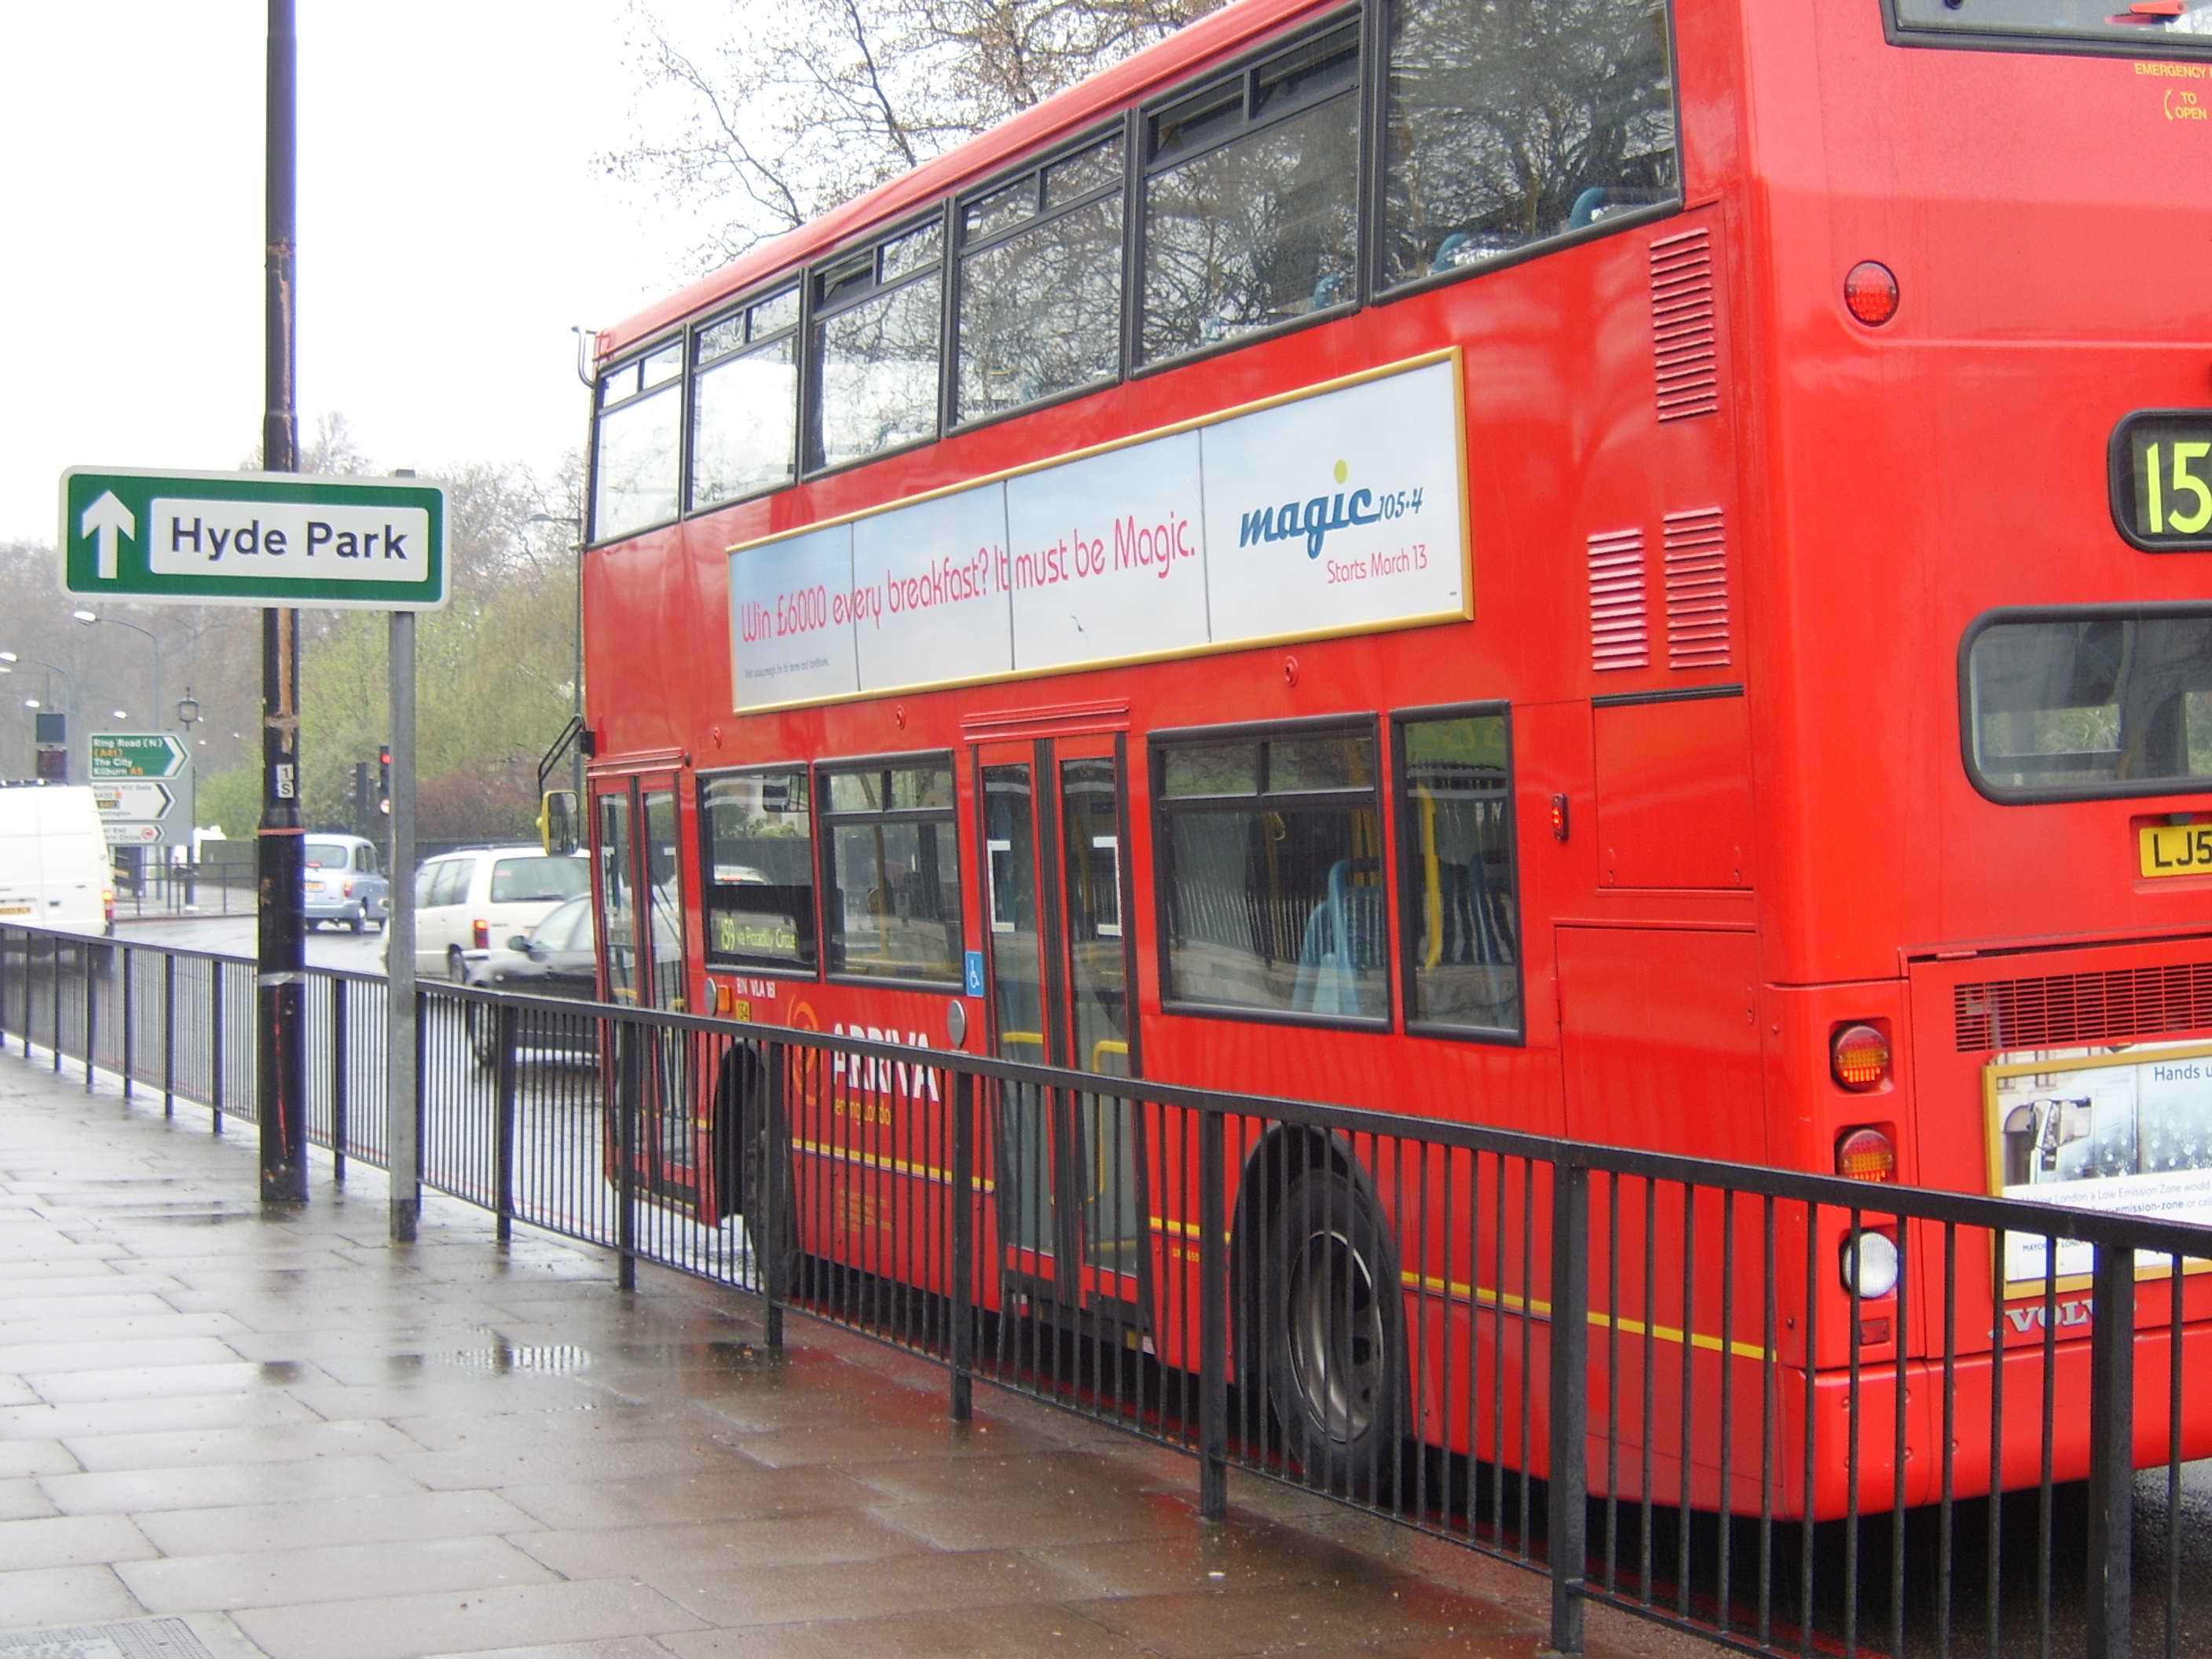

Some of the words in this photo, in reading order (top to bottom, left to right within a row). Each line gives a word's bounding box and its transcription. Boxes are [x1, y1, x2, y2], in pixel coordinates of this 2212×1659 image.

[2134, 62, 2206, 79] EMERGENCY
[2180, 91, 2198, 104] TO
[2175, 107, 2208, 120] OPEN
[1240, 471, 1379, 559] magic
[171, 516, 287, 561] Hyde
[306, 521, 408, 560] Park
[1327, 558, 1368, 584] Starts
[1371, 548, 1410, 578] March
[1412, 544, 1428, 570] 13
[741, 602, 771, 643] Win
[777, 584, 826, 637] £6000
[833, 584, 882, 630] every
[887, 547, 989, 613] breakfast?
[994, 545, 1010, 592] It
[1016, 538, 1069, 590] must
[1074, 528, 1106, 578] be
[1114, 511, 1196, 580] Magic.
[93, 738, 115, 749] Ring
[117, 738, 141, 748] Road
[93, 758, 111, 767] The
[112, 757, 134, 767] City
[93, 767, 127, 776] Kilburn
[281, 783, 291, 795] S
[2154, 1064, 2200, 1082] Hands
[2055, 1191, 2088, 1204] London
[2098, 1189, 2115, 1200] Low
[2119, 1187, 2157, 1198] Emission
[2160, 1184, 2184, 1195] Zone
[2185, 1181, 2210, 1192] would
